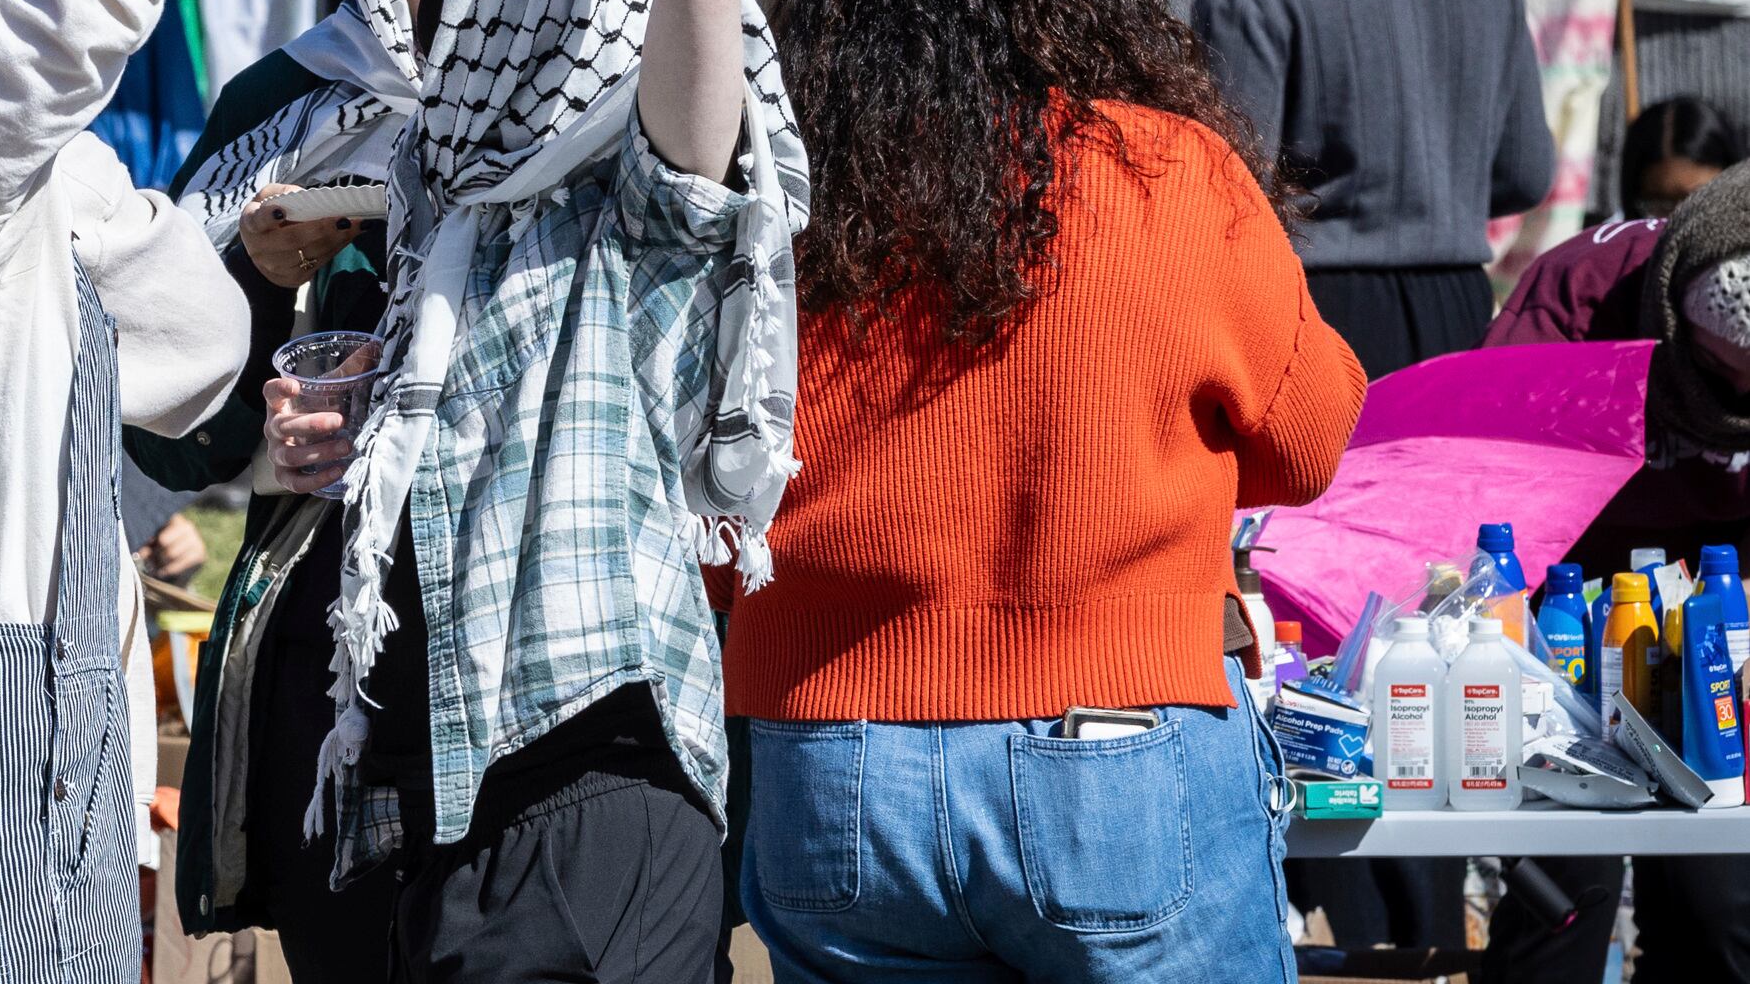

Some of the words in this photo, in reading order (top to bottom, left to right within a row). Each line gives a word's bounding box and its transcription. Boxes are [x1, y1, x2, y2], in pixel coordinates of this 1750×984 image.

[1550, 646, 1585, 657] PORT
[1710, 679, 1730, 693] SPORT
[1471, 688, 1496, 696] TopCare
[1390, 705, 1430, 713] Isopropyl
[1464, 705, 1503, 713] Isopropyl
[1719, 704, 1733, 721] 30
[1275, 714, 1304, 727] Alcohol
[1305, 720, 1323, 732] Prep
[1324, 724, 1344, 735] Pads
[1334, 789, 1357, 797] fabric
[1329, 797, 1357, 805] flexible
